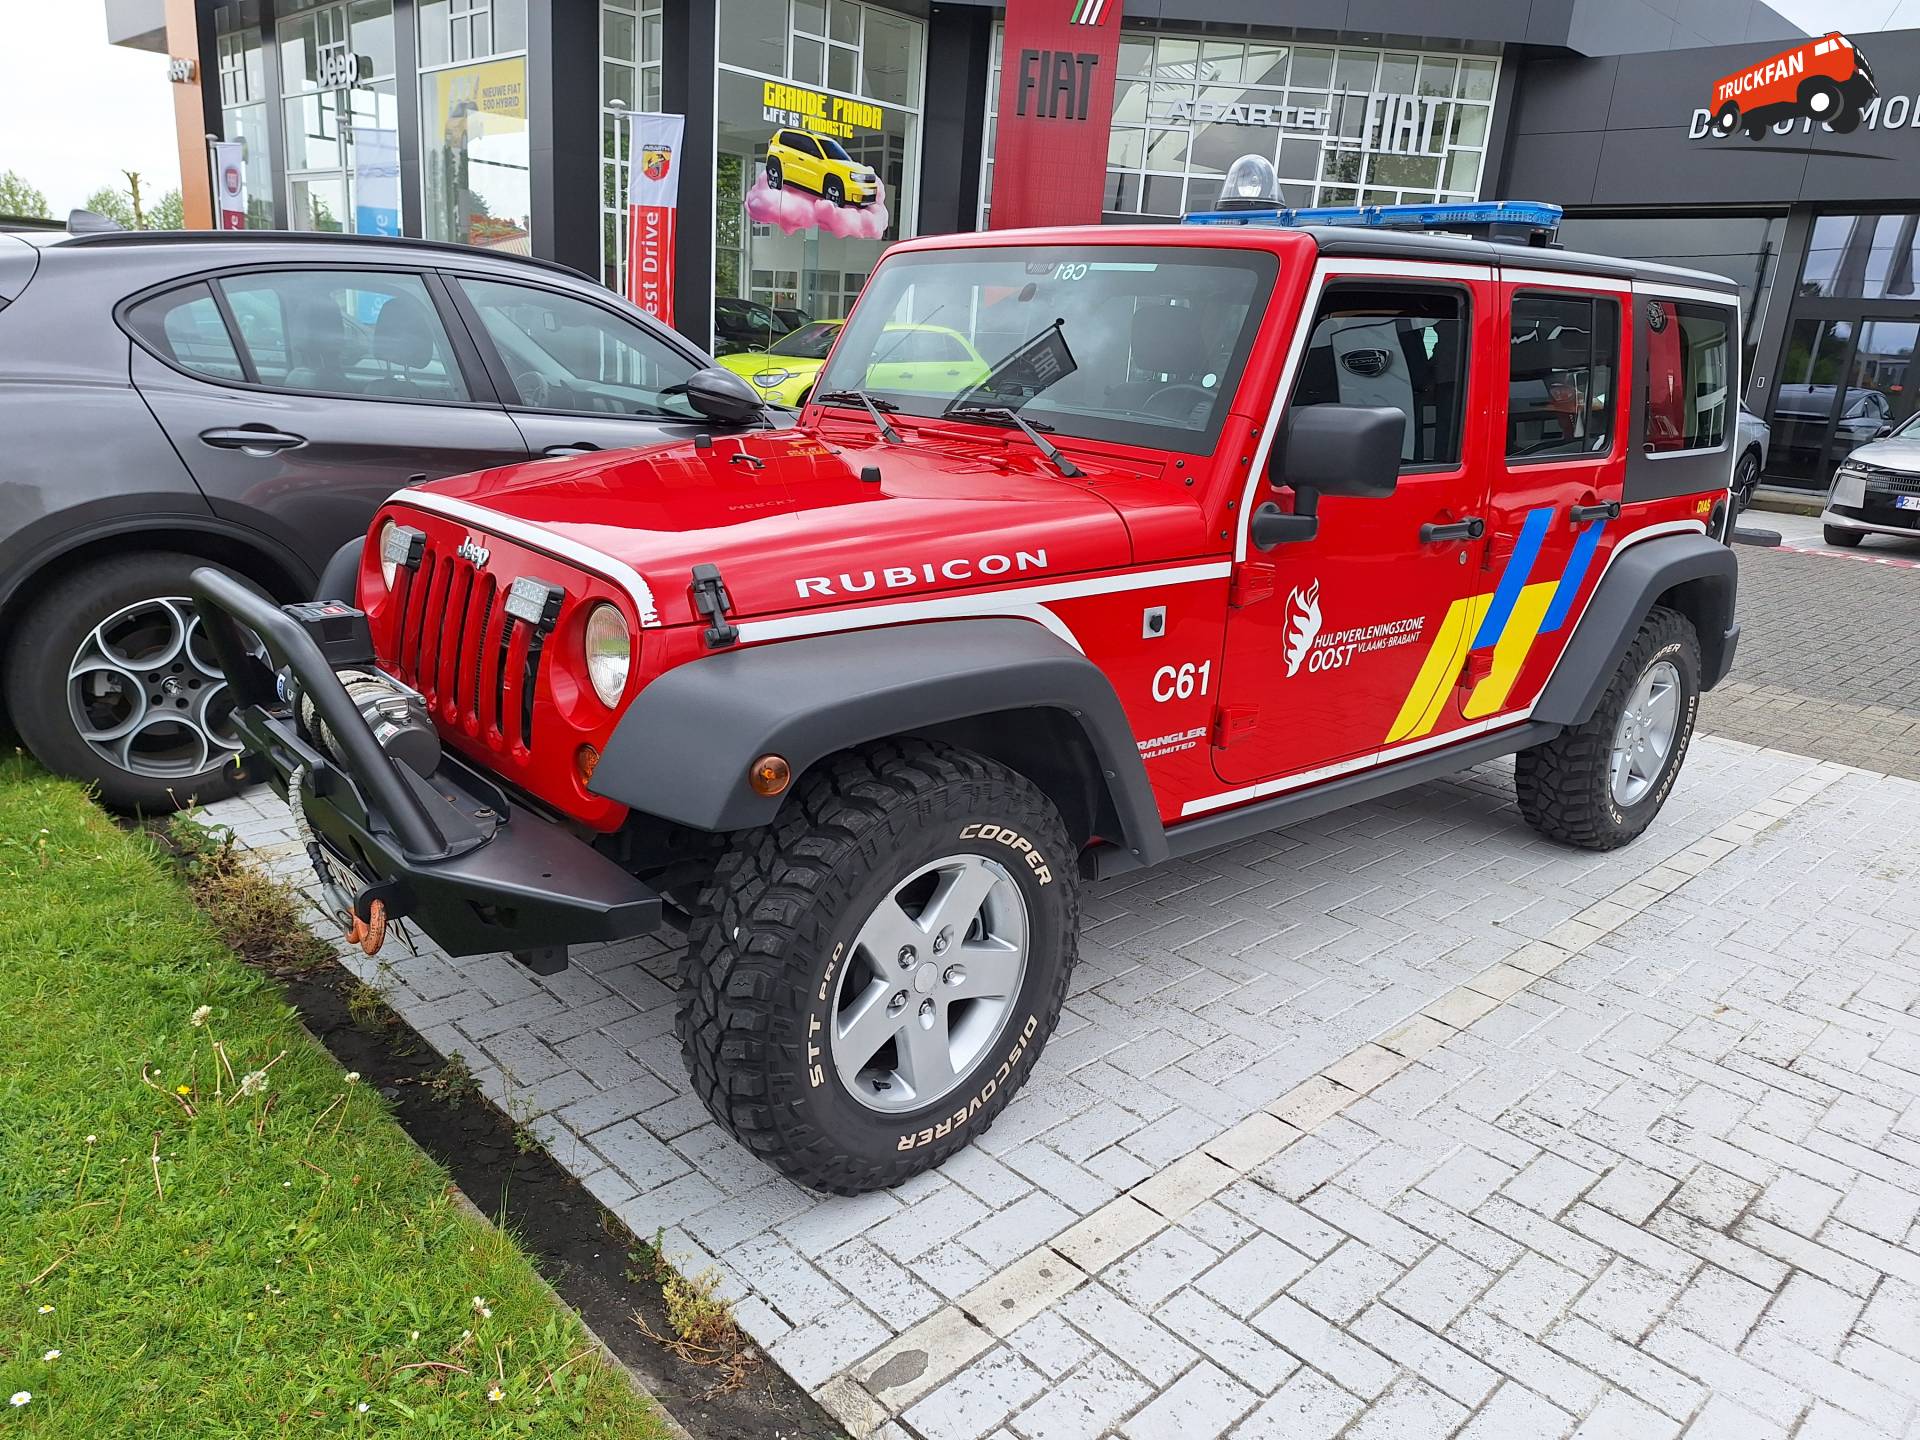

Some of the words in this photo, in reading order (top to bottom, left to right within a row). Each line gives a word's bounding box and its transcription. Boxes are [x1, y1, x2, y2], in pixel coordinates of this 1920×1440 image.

[318, 49, 359, 90] Jeep
[482, 85, 506, 98] NIEUWE
[507, 82, 521, 95] FIAT
[1017, 49, 1099, 120] FIAT
[482, 98, 495, 111] 500
[496, 95, 519, 109] HYBRID
[763, 81, 828, 118] GRANDE
[832, 97, 883, 130] PANDA
[763, 106, 786, 127] LIFE
[788, 111, 799, 128] IS
[801, 114, 854, 139] PANDASTIC
[1166, 99, 1330, 129] ABARTH
[1361, 92, 1443, 155] FIAT
[641, 211, 659, 273] Drive
[1031, 346, 1061, 381] FIAT
[457, 535, 490, 570] Jeep
[794, 549, 1048, 598] RUBICON
[1308, 644, 1357, 673] OOST
[1357, 631, 1422, 653] VLAAMS-BRABANT
[1314, 616, 1426, 649] HULPVERLENINGSZONE
[1152, 659, 1211, 703] C61
[1136, 727, 1207, 751] RANGLER
[1655, 695, 1696, 803] DISCOVERER
[959, 823, 1053, 887] COOPER
[808, 1013, 825, 1088] STT
[818, 941, 844, 1001] PRO
[897, 1014, 1038, 1151] DISCOVERER
